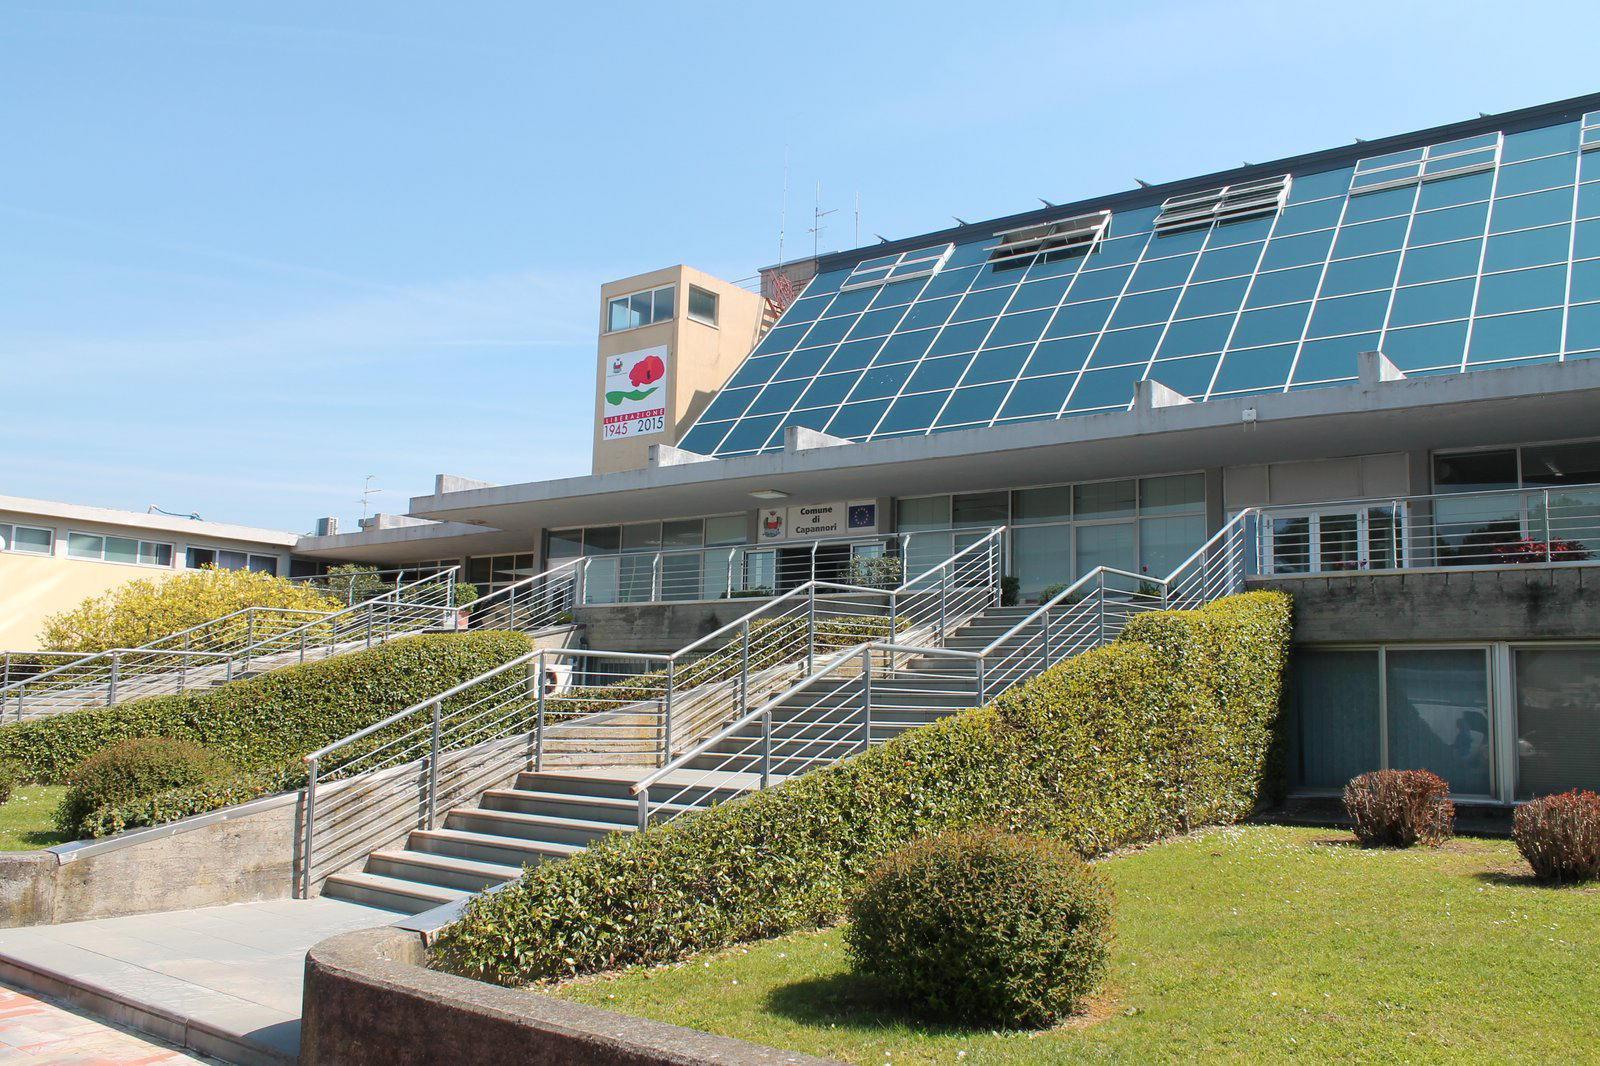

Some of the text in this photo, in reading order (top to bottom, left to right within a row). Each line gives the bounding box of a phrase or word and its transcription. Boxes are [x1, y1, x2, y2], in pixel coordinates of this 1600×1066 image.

[605, 409, 664, 424] LIBERAZIONE
[604, 416, 663, 437] 1945 2015
[800, 506, 832, 515] Comune
[812, 515, 820, 523] di
[796, 523, 837, 534] Capannori
